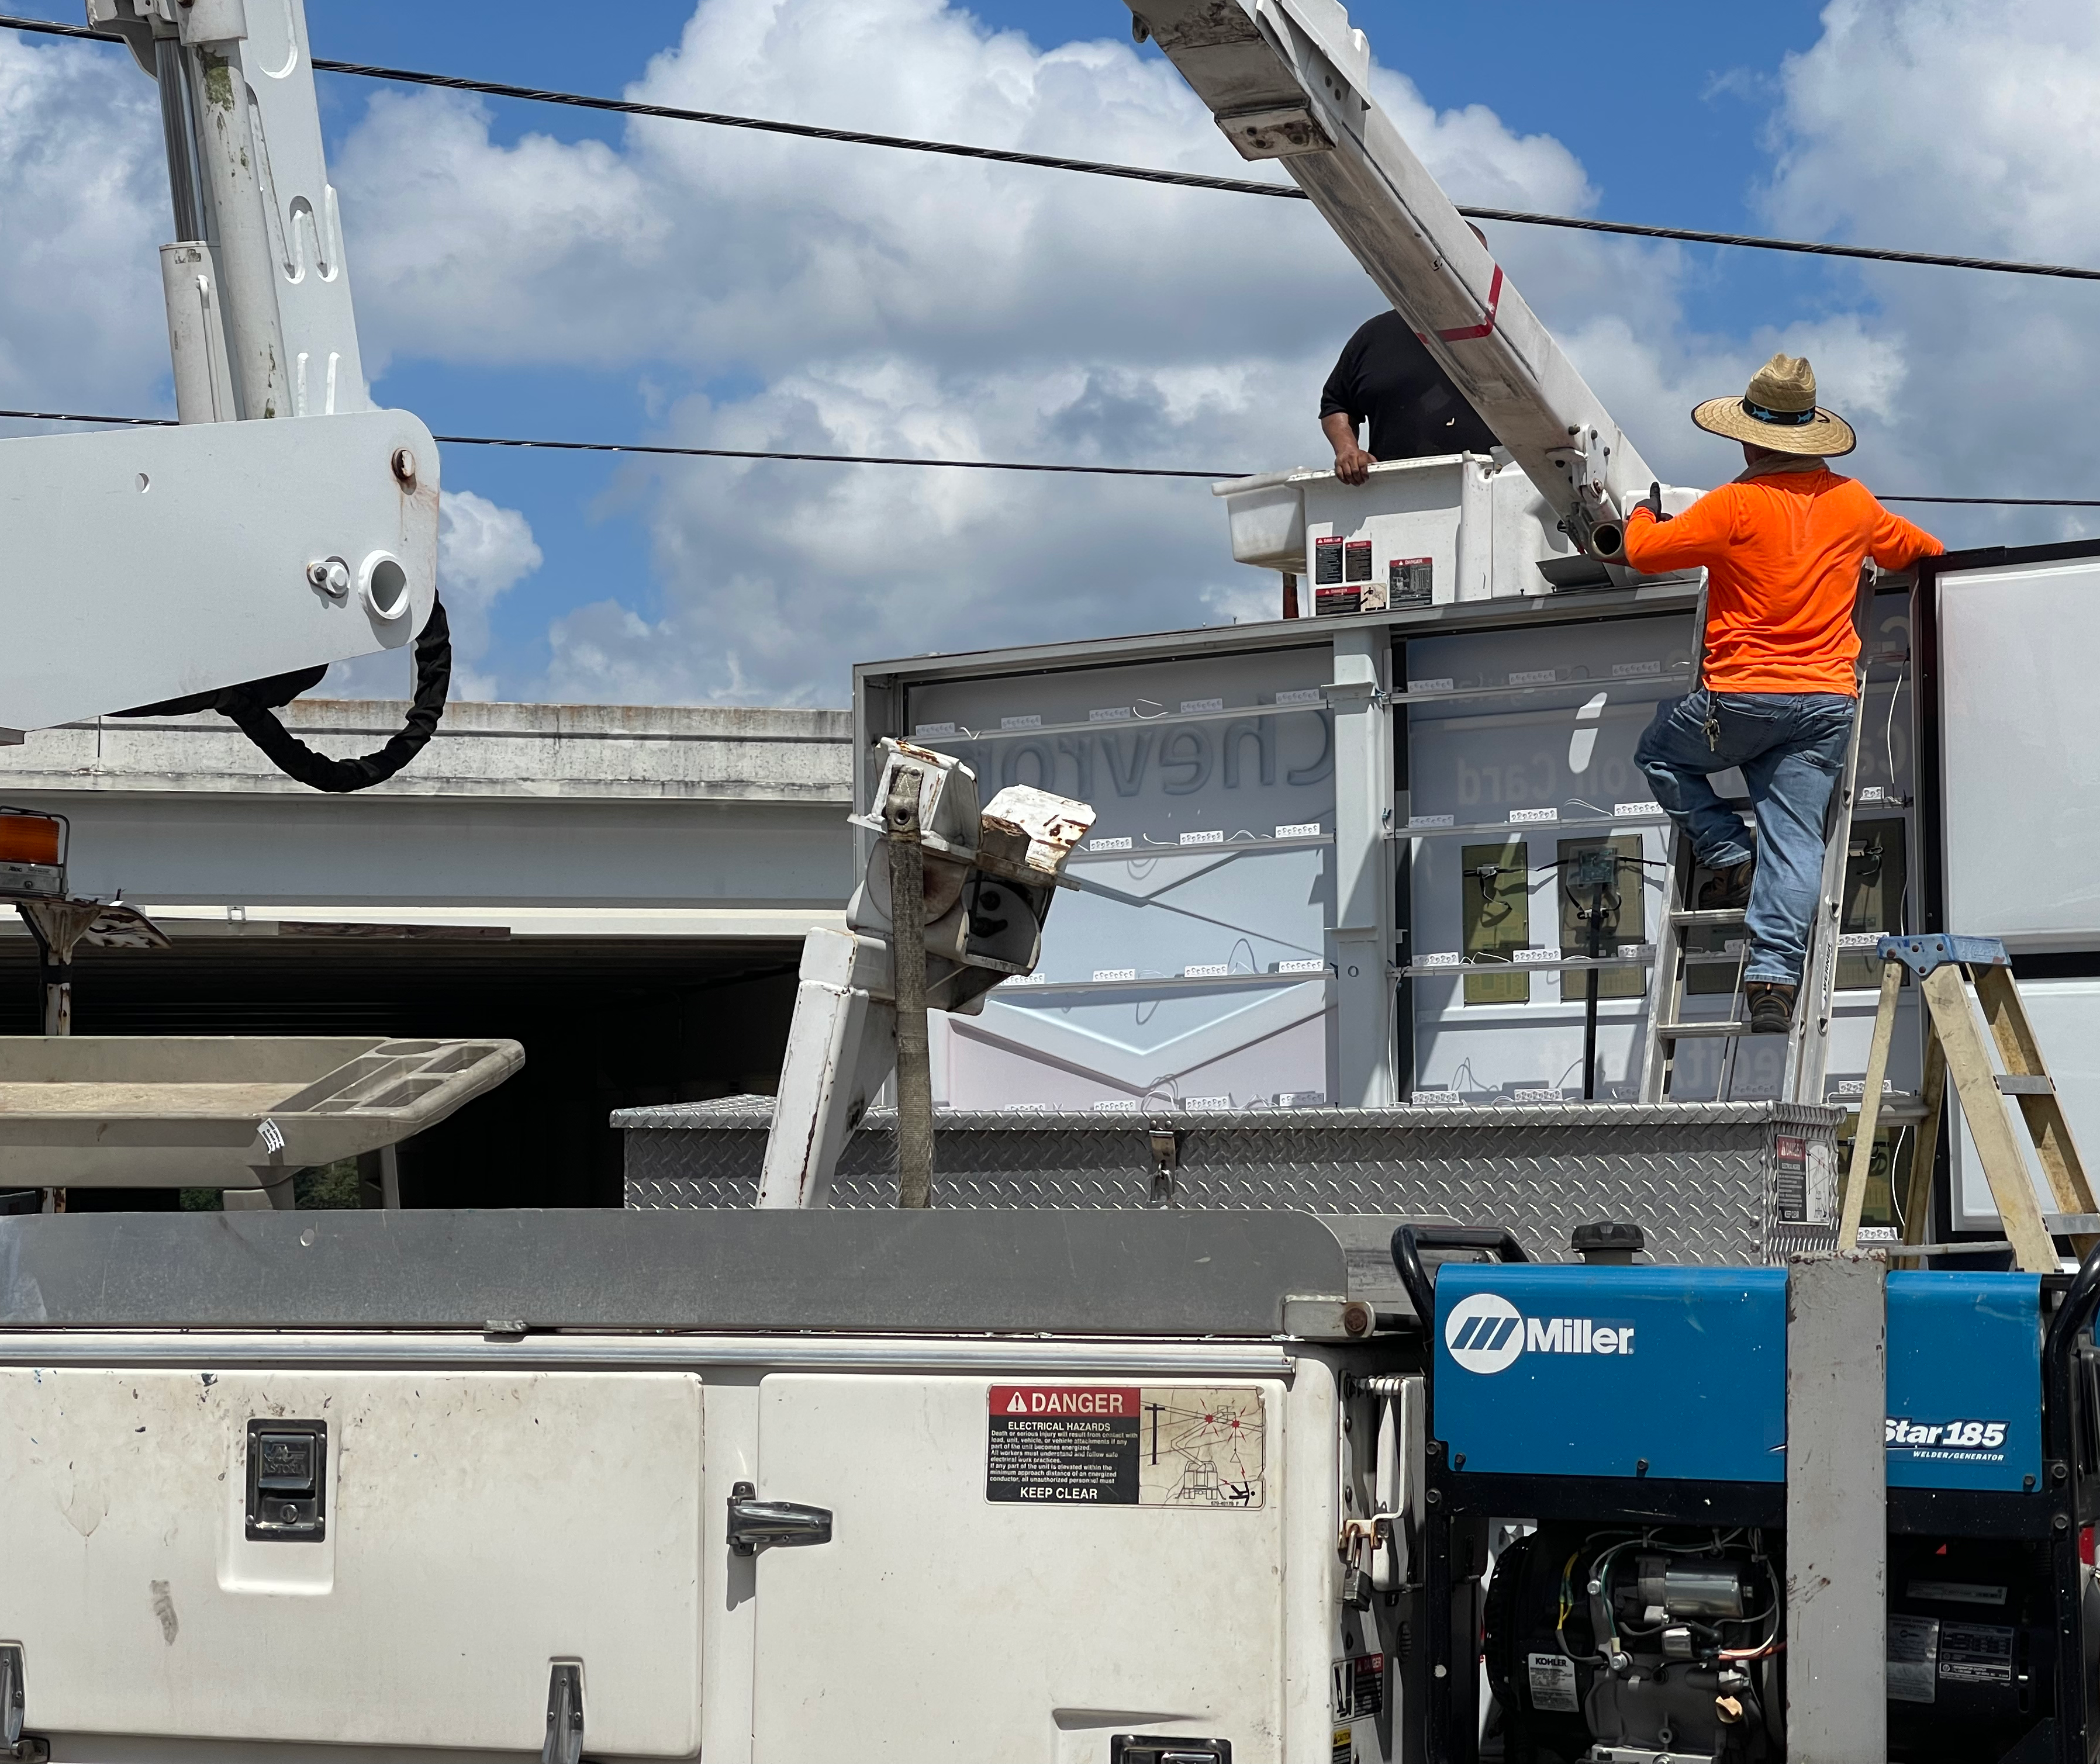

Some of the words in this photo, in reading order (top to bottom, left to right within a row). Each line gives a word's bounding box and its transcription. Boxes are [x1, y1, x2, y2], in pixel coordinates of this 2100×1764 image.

[1527, 1317, 1634, 1354] Miller
[1031, 1393, 1123, 1413] DANGER
[1008, 1421, 1064, 1431] ELECTRICAL
[1066, 1422, 1110, 1431] HAZARDS
[1942, 1422, 2006, 1447] 185
[1913, 1451, 2004, 1461] WELDER/GENERATOR
[1020, 1486, 1053, 1498] KEEP
[1056, 1488, 1097, 1499] CLEAR
[1535, 1658, 1567, 1666] KOHLER
